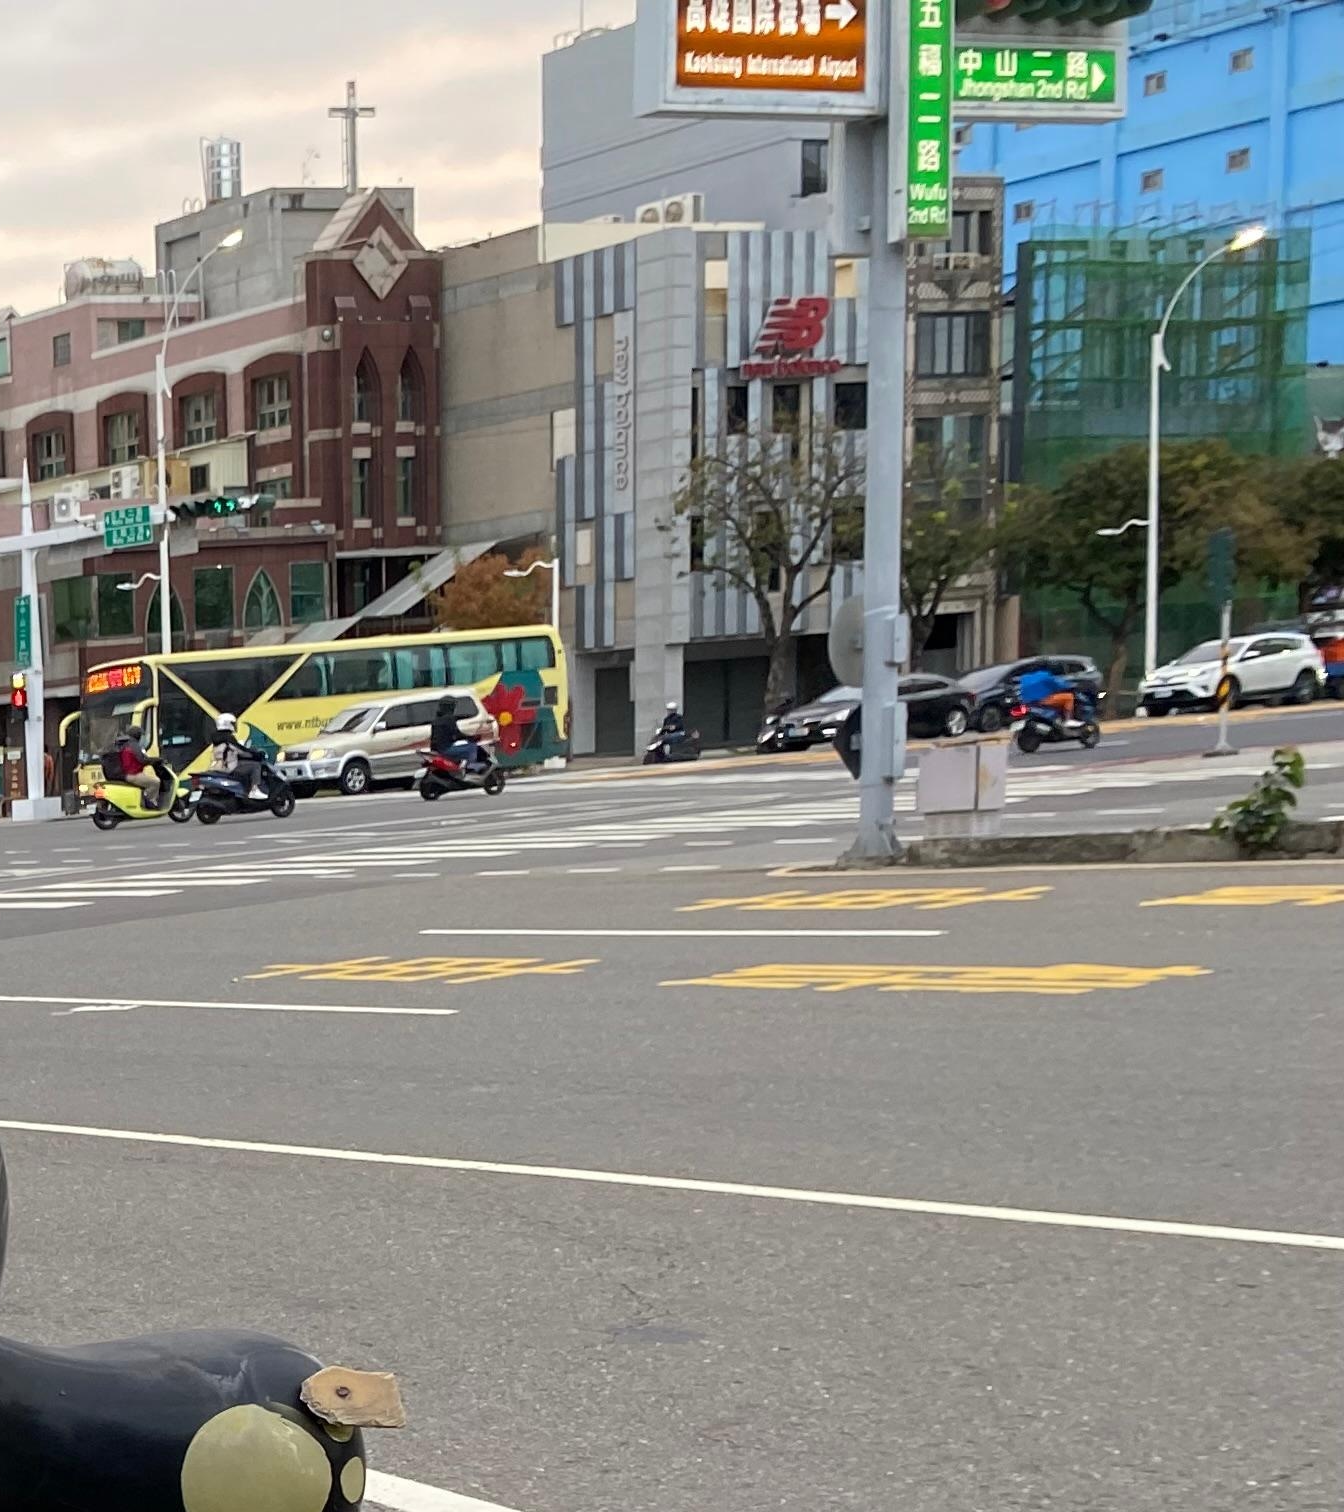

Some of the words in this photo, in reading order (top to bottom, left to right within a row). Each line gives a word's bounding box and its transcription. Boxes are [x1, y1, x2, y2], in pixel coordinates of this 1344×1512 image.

[684, 51, 743, 79] Kaohsiung
[747, 53, 815, 76] International
[818, 55, 858, 81] Airport
[958, 48, 1089, 78] 中山二路
[917, 0, 943, 172] 五福二路
[1037, 79, 1063, 98] 2nd
[910, 183, 947, 201] Wufu
[908, 206, 928, 224] 2nd
[616, 336, 630, 388] new
[615, 391, 632, 492] balance
